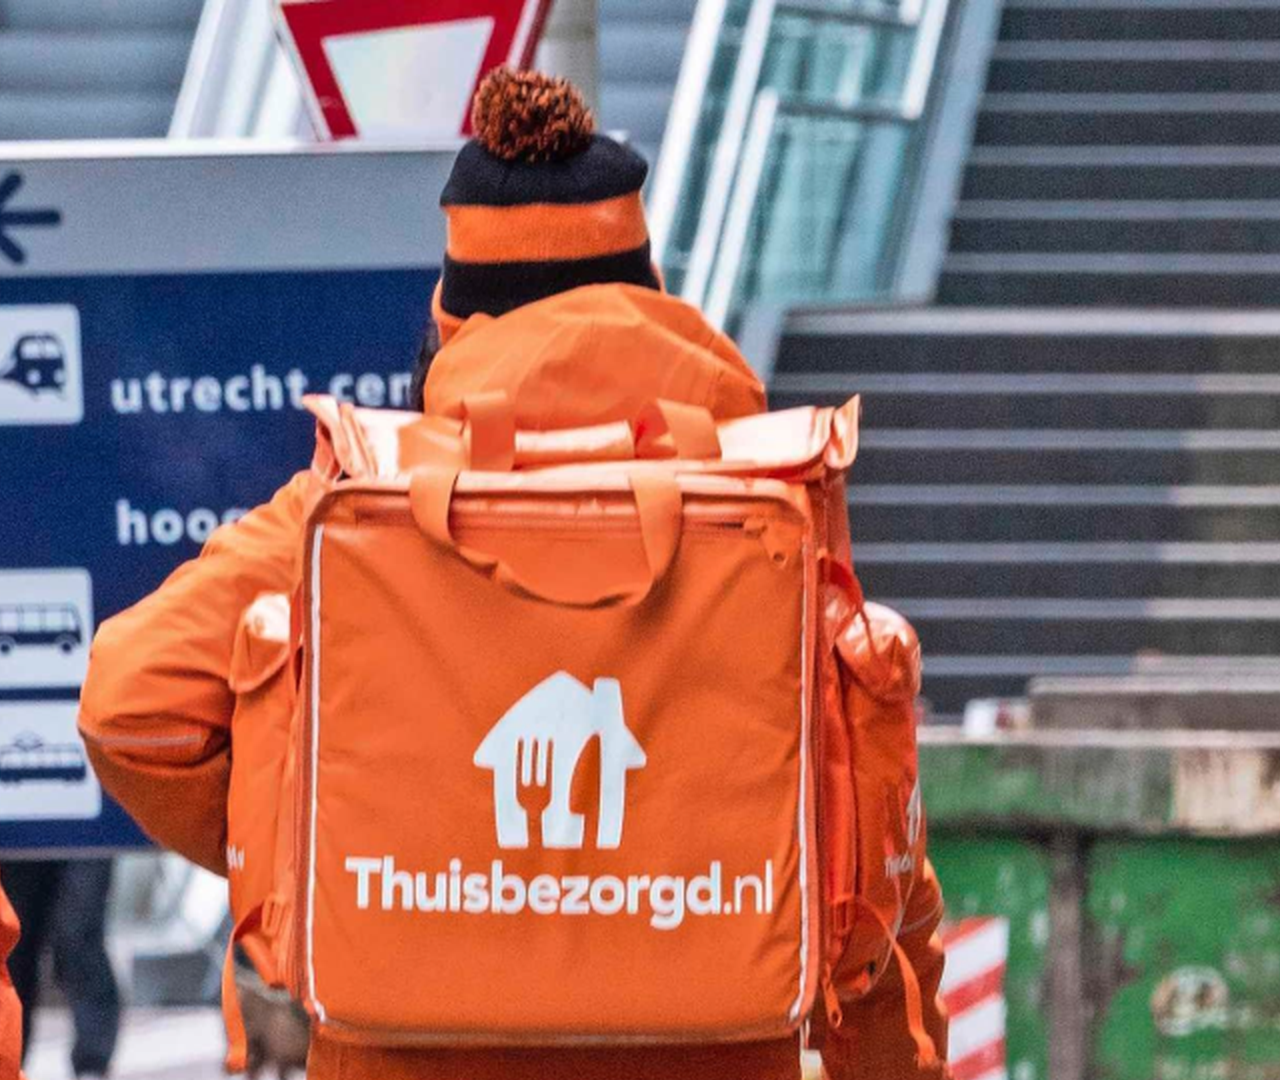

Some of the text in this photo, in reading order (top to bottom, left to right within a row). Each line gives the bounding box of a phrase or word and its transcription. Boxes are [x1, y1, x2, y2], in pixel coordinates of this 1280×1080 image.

[111, 363, 412, 414] utrecht cen
[344, 856, 774, 930] Thuisbezorgd.nl
